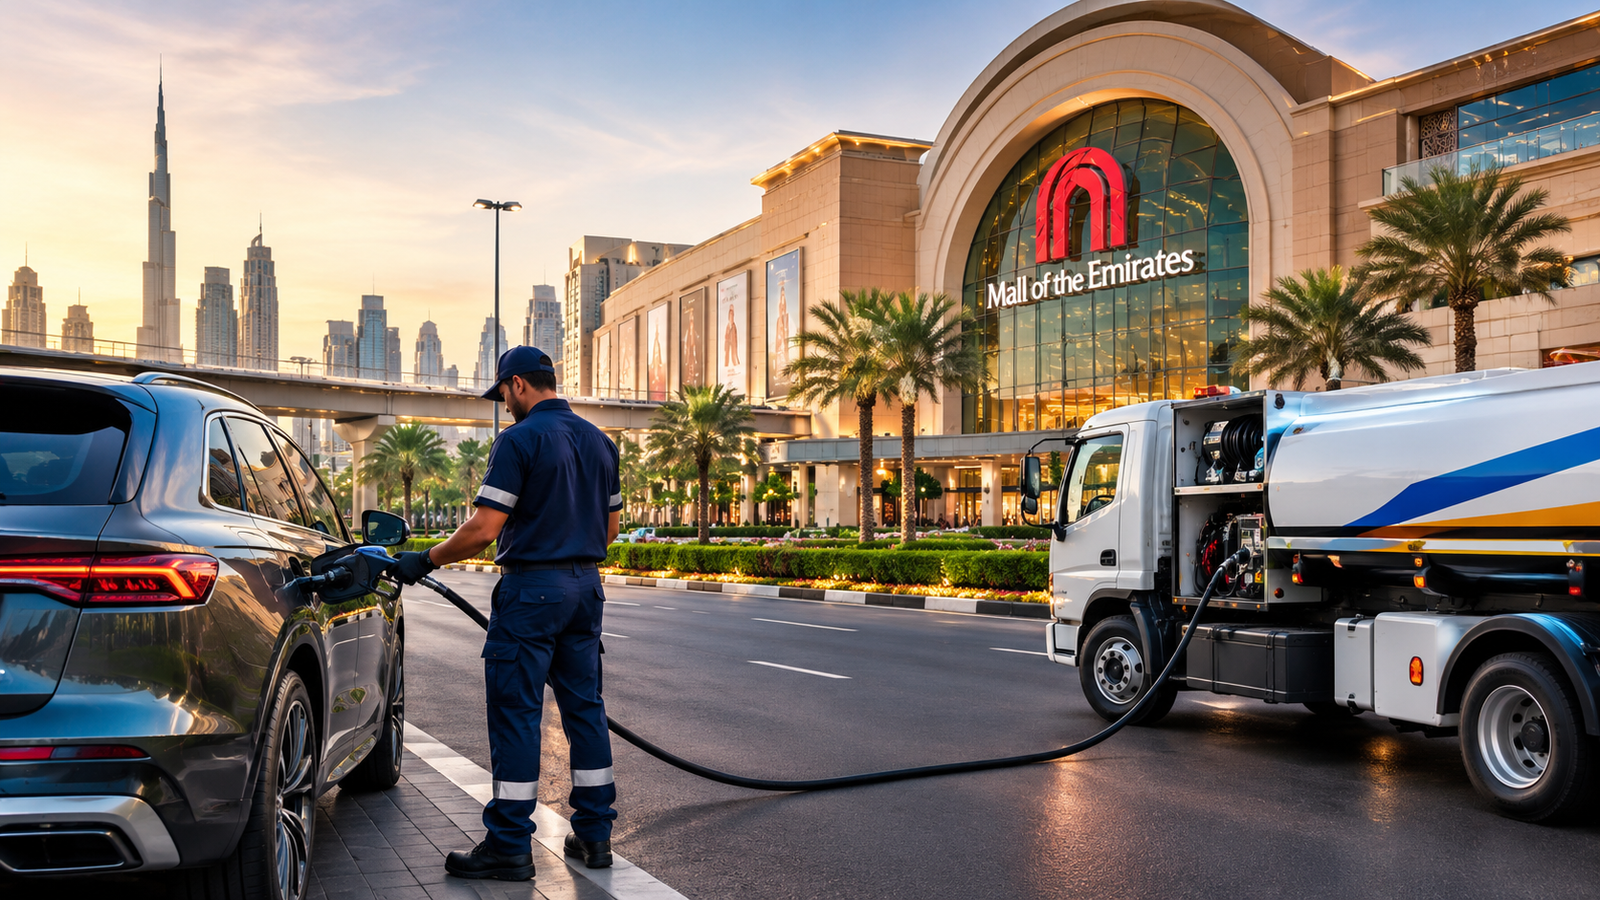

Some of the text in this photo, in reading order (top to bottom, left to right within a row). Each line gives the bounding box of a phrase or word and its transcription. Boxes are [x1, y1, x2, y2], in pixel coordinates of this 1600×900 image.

[987, 249, 1194, 309] Mall of the Emirates
